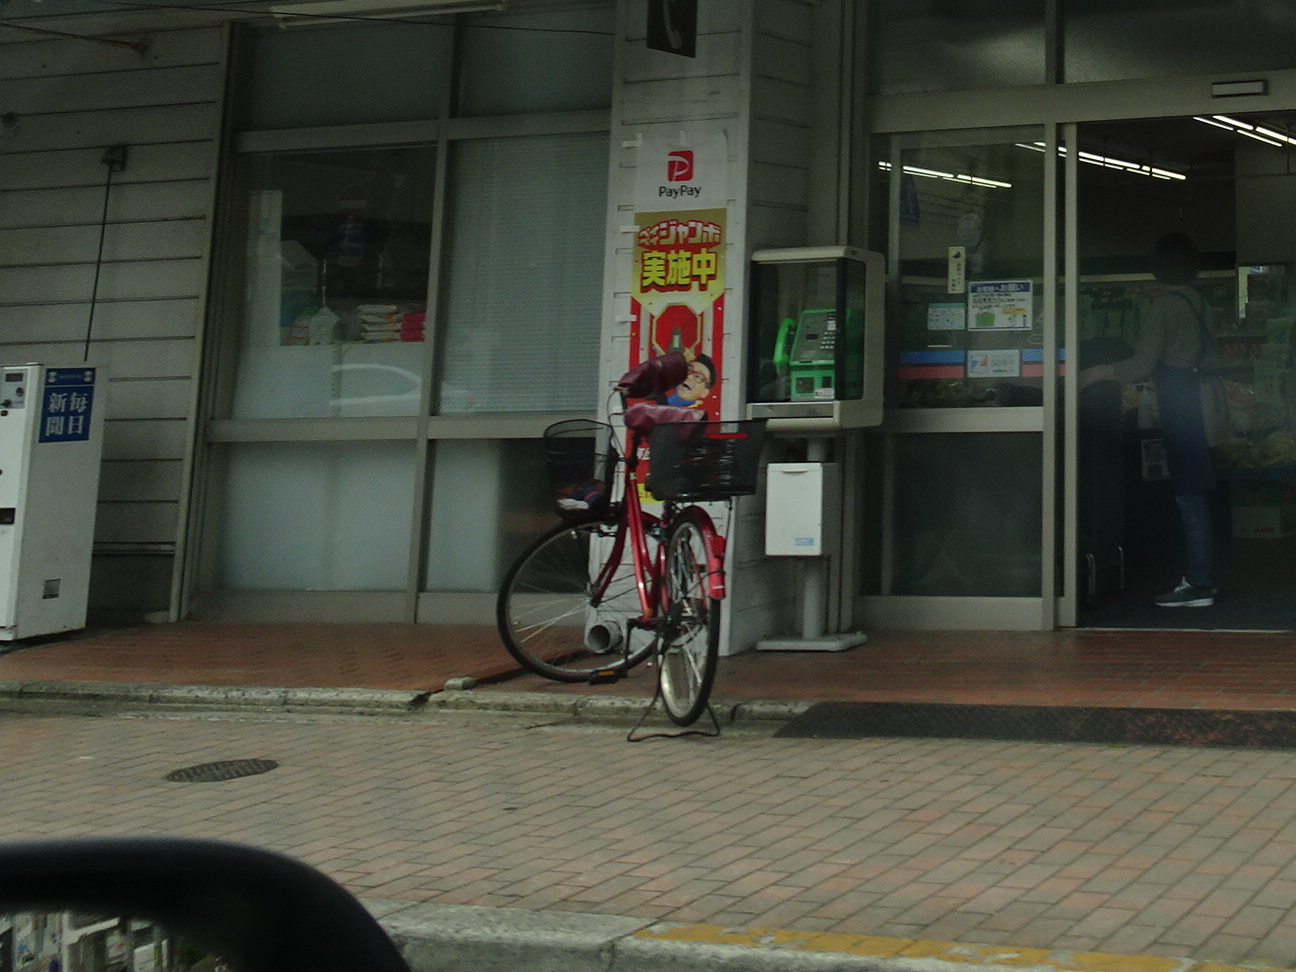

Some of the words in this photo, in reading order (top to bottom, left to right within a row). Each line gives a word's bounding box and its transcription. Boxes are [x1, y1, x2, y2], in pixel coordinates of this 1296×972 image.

[658, 185, 702, 199] PayPay
[641, 247, 717, 288] 実施中
